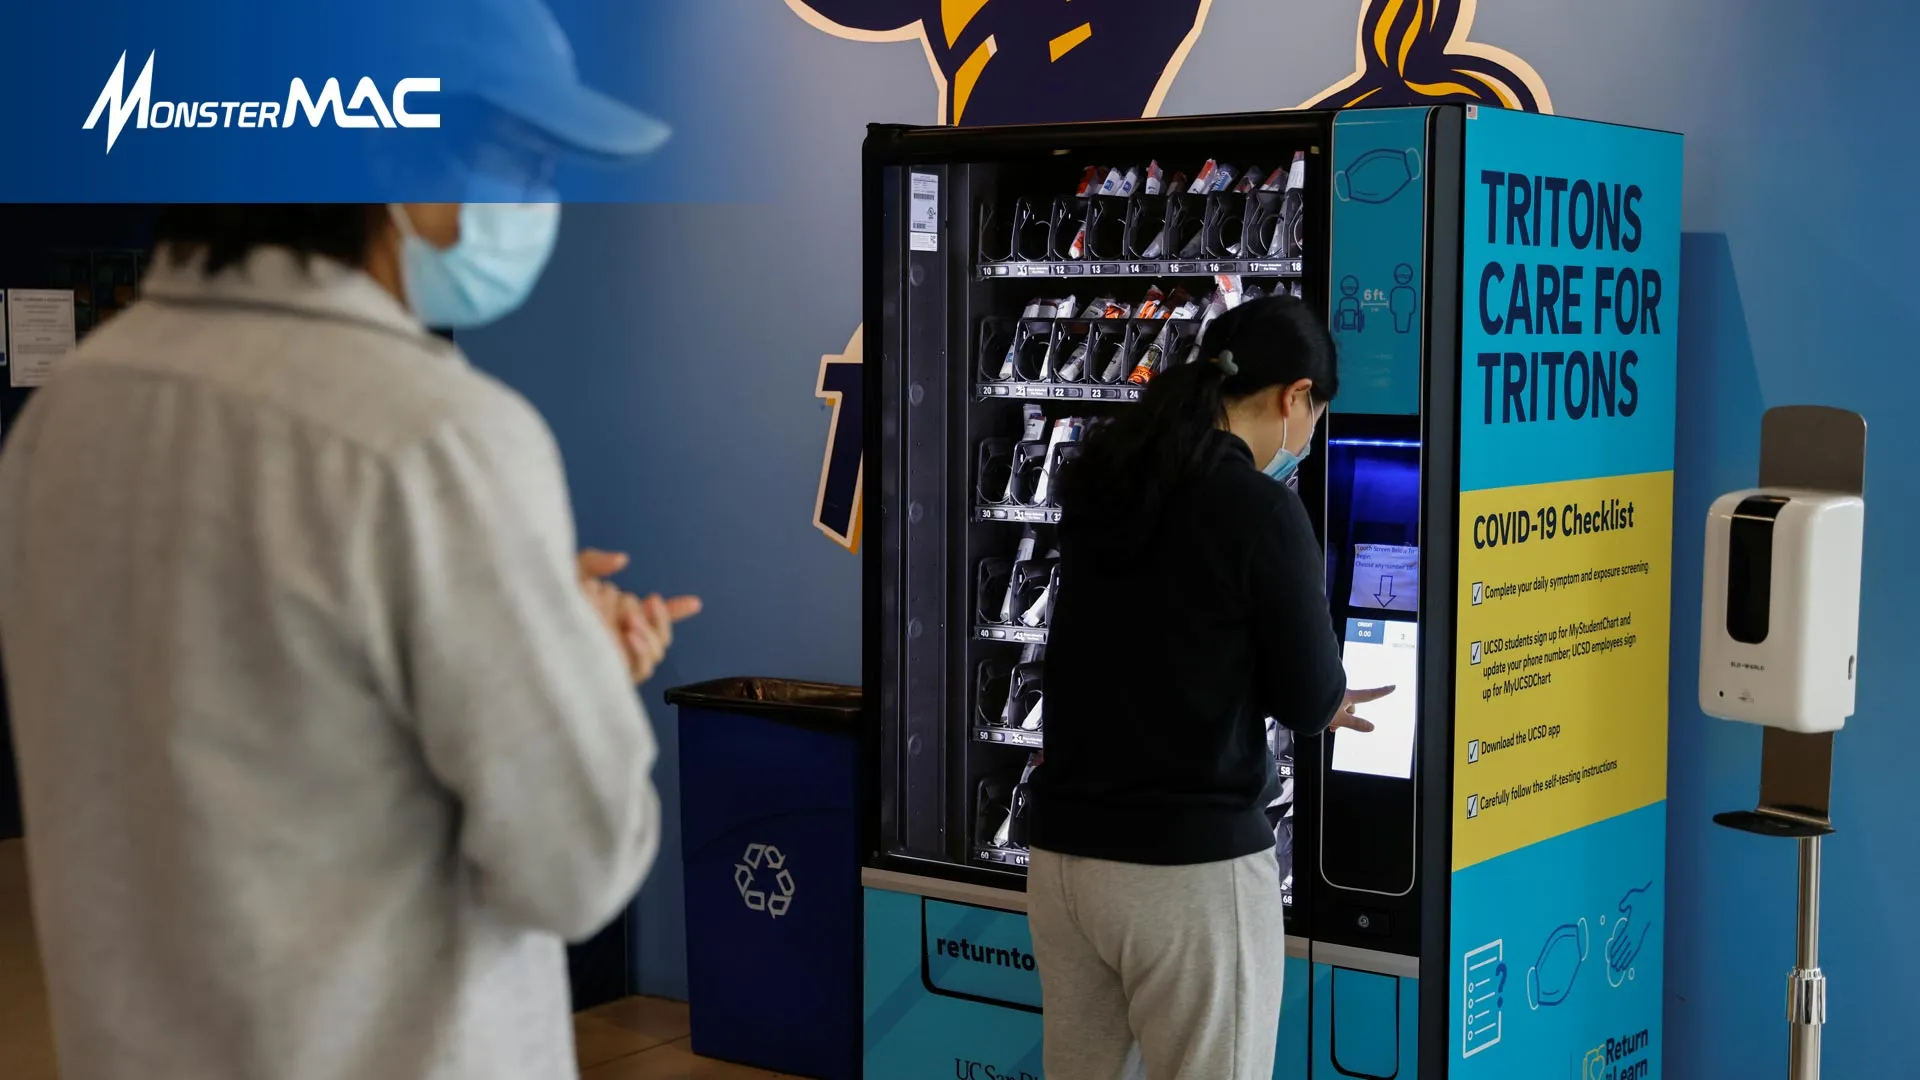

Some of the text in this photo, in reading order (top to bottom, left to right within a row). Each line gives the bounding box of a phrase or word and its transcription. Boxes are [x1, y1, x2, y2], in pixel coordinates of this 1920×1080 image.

[1481, 169, 1643, 253] TRITONS
[983, 267, 991, 275] 10
[1055, 266, 1065, 274] 12
[1092, 265, 1100, 274] 13
[1130, 264, 1139, 273] 14
[1170, 264, 1179, 273] 15
[1210, 263, 1219, 272] 16
[1250, 263, 1259, 272] 17
[1292, 262, 1301, 271] 18
[1364, 288, 1371, 301] 6
[1479, 261, 1661, 335] CARE FOR
[983, 386, 991, 395] 20
[1055, 388, 1064, 396] 22
[1092, 389, 1101, 397] 23
[1130, 390, 1138, 398] 24
[1477, 350, 1639, 424] TRITONS
[982, 510, 991, 518] 30
[1473, 499, 1634, 549] COVID-19 Checklist
[1485, 560, 1649, 600] Complete your daily symptom and exposure screening
[980, 629, 989, 638] 40
[1483, 612, 1631, 655] UCSD students sign up for MyStudentChart and
[1483, 632, 1636, 678] update your phone number; UCSD employees sign
[1482, 672, 1551, 703] up for MyUCSDChart
[980, 731, 988, 740] 50
[1481, 723, 1560, 755] Download the UCSD app
[1280, 766, 1291, 775] 58
[1480, 759, 1617, 810] Carefully follow the self-testing instructions
[980, 851, 1024, 865] 60 61
[1282, 895, 1292, 904] 68
[937, 937, 1037, 972] returnto
[1606, 1028, 1648, 1066] Return
[955, 1057, 982, 1080] UC
